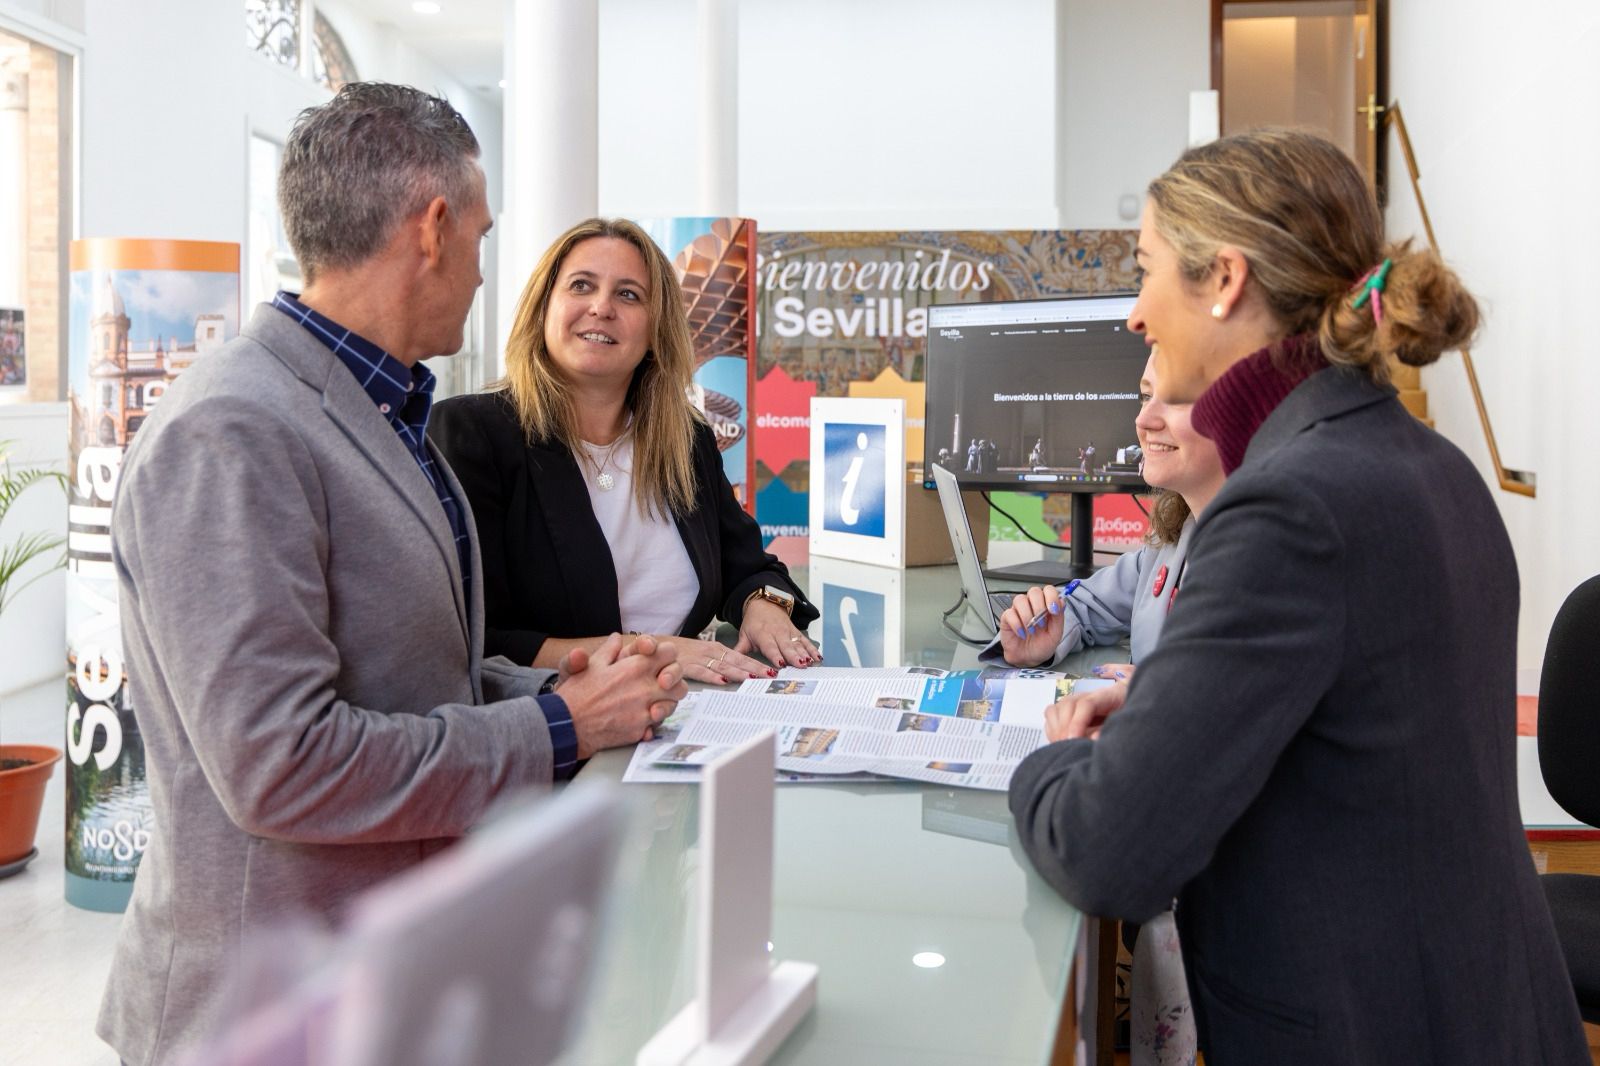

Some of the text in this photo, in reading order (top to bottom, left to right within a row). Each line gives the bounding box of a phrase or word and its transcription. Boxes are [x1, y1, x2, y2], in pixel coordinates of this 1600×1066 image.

[773, 296, 928, 338] Sevilla
[993, 393, 1038, 402] Bienvenidos
[1045, 393, 1053, 401] la
[1053, 392, 1074, 401] tierra
[1075, 392, 1085, 400] de
[1086, 392, 1098, 400] los
[713, 422, 740, 438] ND
[760, 523, 810, 537] nvenu
[1093, 516, 1143, 535] Добро
